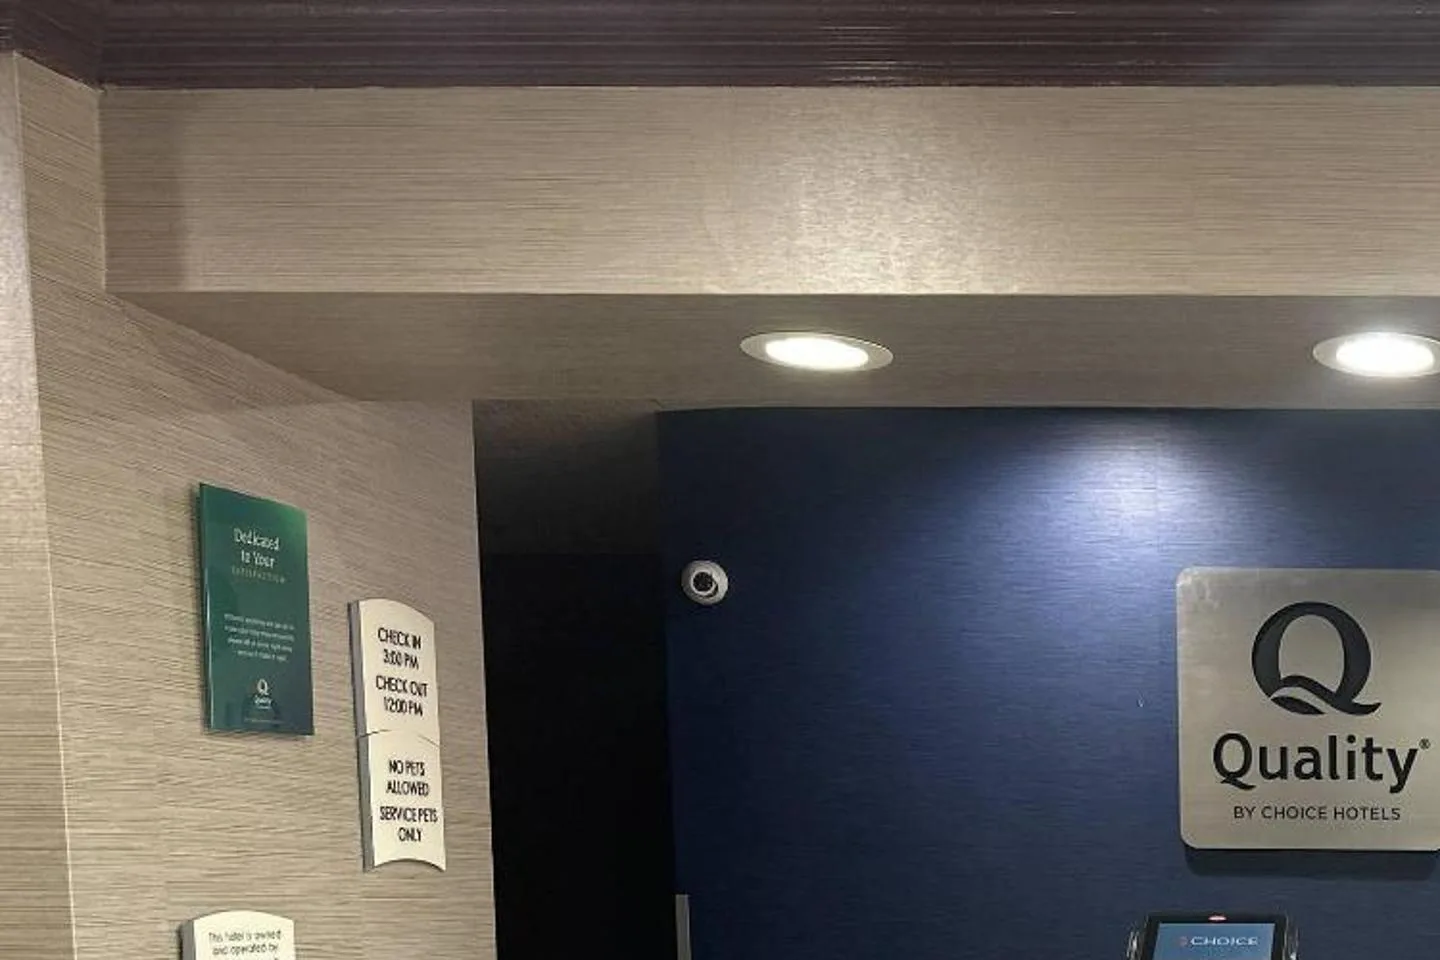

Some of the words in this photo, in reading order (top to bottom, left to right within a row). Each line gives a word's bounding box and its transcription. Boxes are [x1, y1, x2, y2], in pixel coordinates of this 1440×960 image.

[377, 627, 411, 648] CHECK
[411, 635, 422, 650] IN
[404, 652, 419, 670] PM
[1252, 601, 1382, 716] Q
[375, 675, 408, 693] CHECK
[410, 681, 428, 698] OUT
[408, 700, 423, 717] PM
[388, 760, 404, 774] NO
[405, 761, 425, 776] PETS
[385, 780, 430, 797] ALLOWED
[379, 806, 417, 822] SERVICE
[417, 807, 439, 823] PETS
[1233, 806, 1256, 820] BY
[1261, 806, 1328, 820] CHOICE
[1333, 807, 1401, 821] HOTELS
[397, 826, 424, 842] ONLY
[208, 931, 223, 943] This
[224, 931, 244, 941] hotel
[246, 932, 252, 940] is
[254, 929, 282, 940] owned
[1190, 936, 1258, 946] CHOICE
[212, 946, 228, 956] and
[230, 943, 267, 956] operated
[268, 943, 278, 954] by
